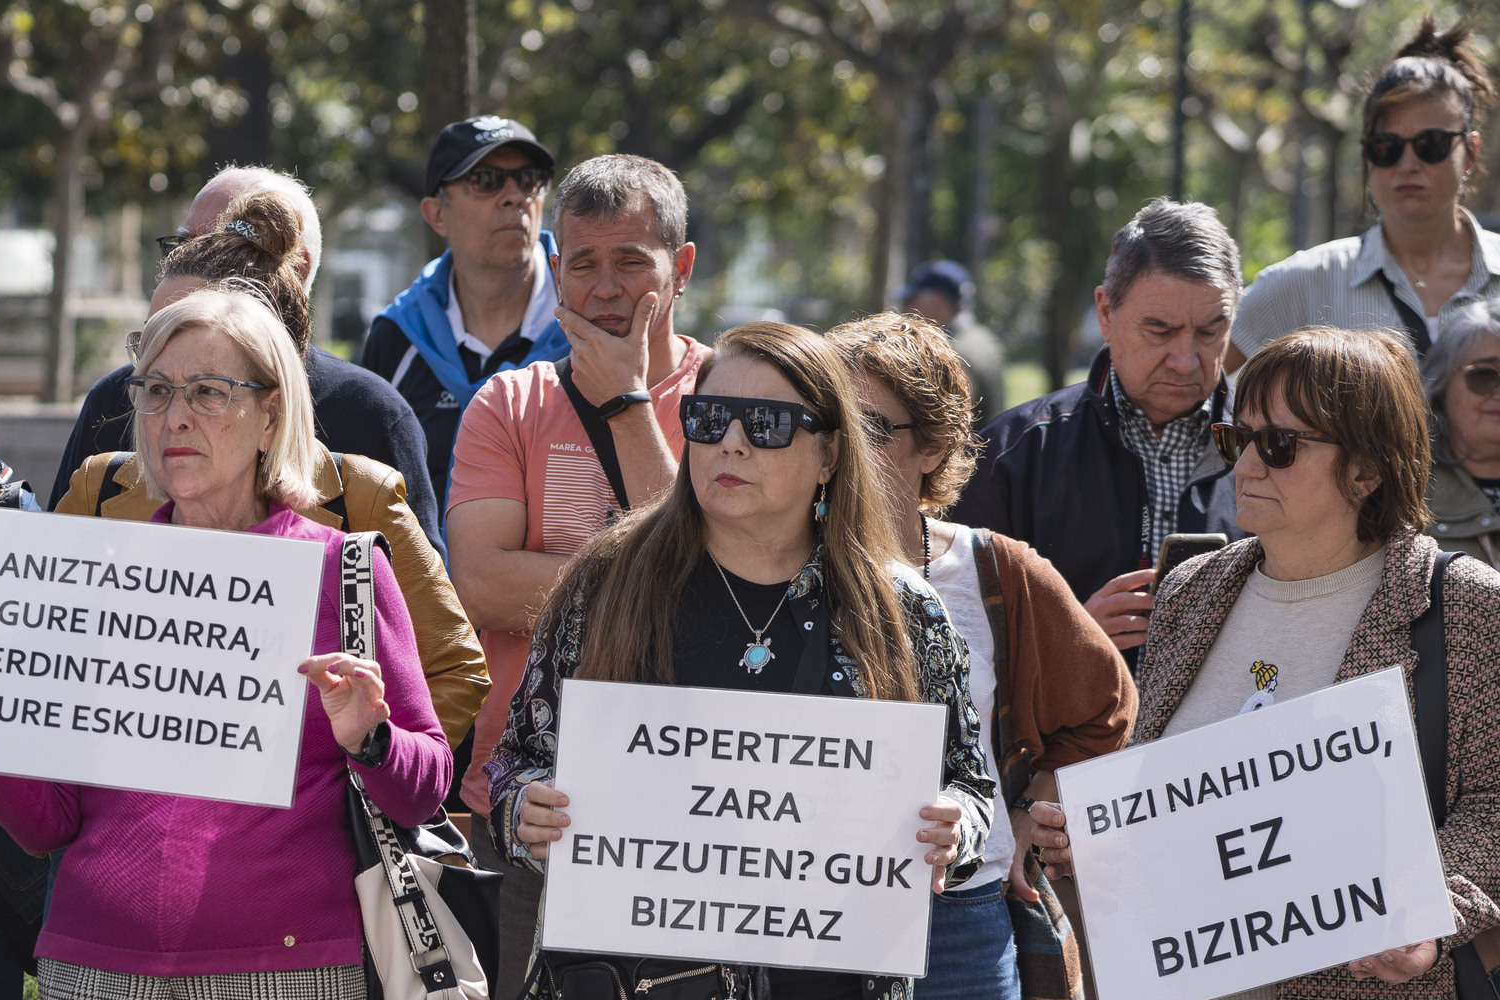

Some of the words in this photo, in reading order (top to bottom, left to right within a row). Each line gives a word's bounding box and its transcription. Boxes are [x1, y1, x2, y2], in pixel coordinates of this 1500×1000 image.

[550, 443, 582, 452] MAREA
[227, 576, 275, 608] DA
[97, 610, 261, 661] INDARRA,
[237, 675, 286, 707] DA
[71, 704, 264, 753] ESKUBIDEA
[626, 723, 874, 771] ASPERTZEN
[1086, 788, 1158, 837] BIZI
[1164, 757, 1261, 814] NAHI
[1268, 721, 1393, 783] DUGU,
[688, 785, 802, 824] ZARA
[571, 833, 815, 882] ENTZUTEN?
[824, 853, 914, 890] GUK
[1215, 816, 1293, 881] EZ
[631, 895, 843, 943] BIZITZEAZ
[1151, 876, 1388, 979] BIZIRAUN
